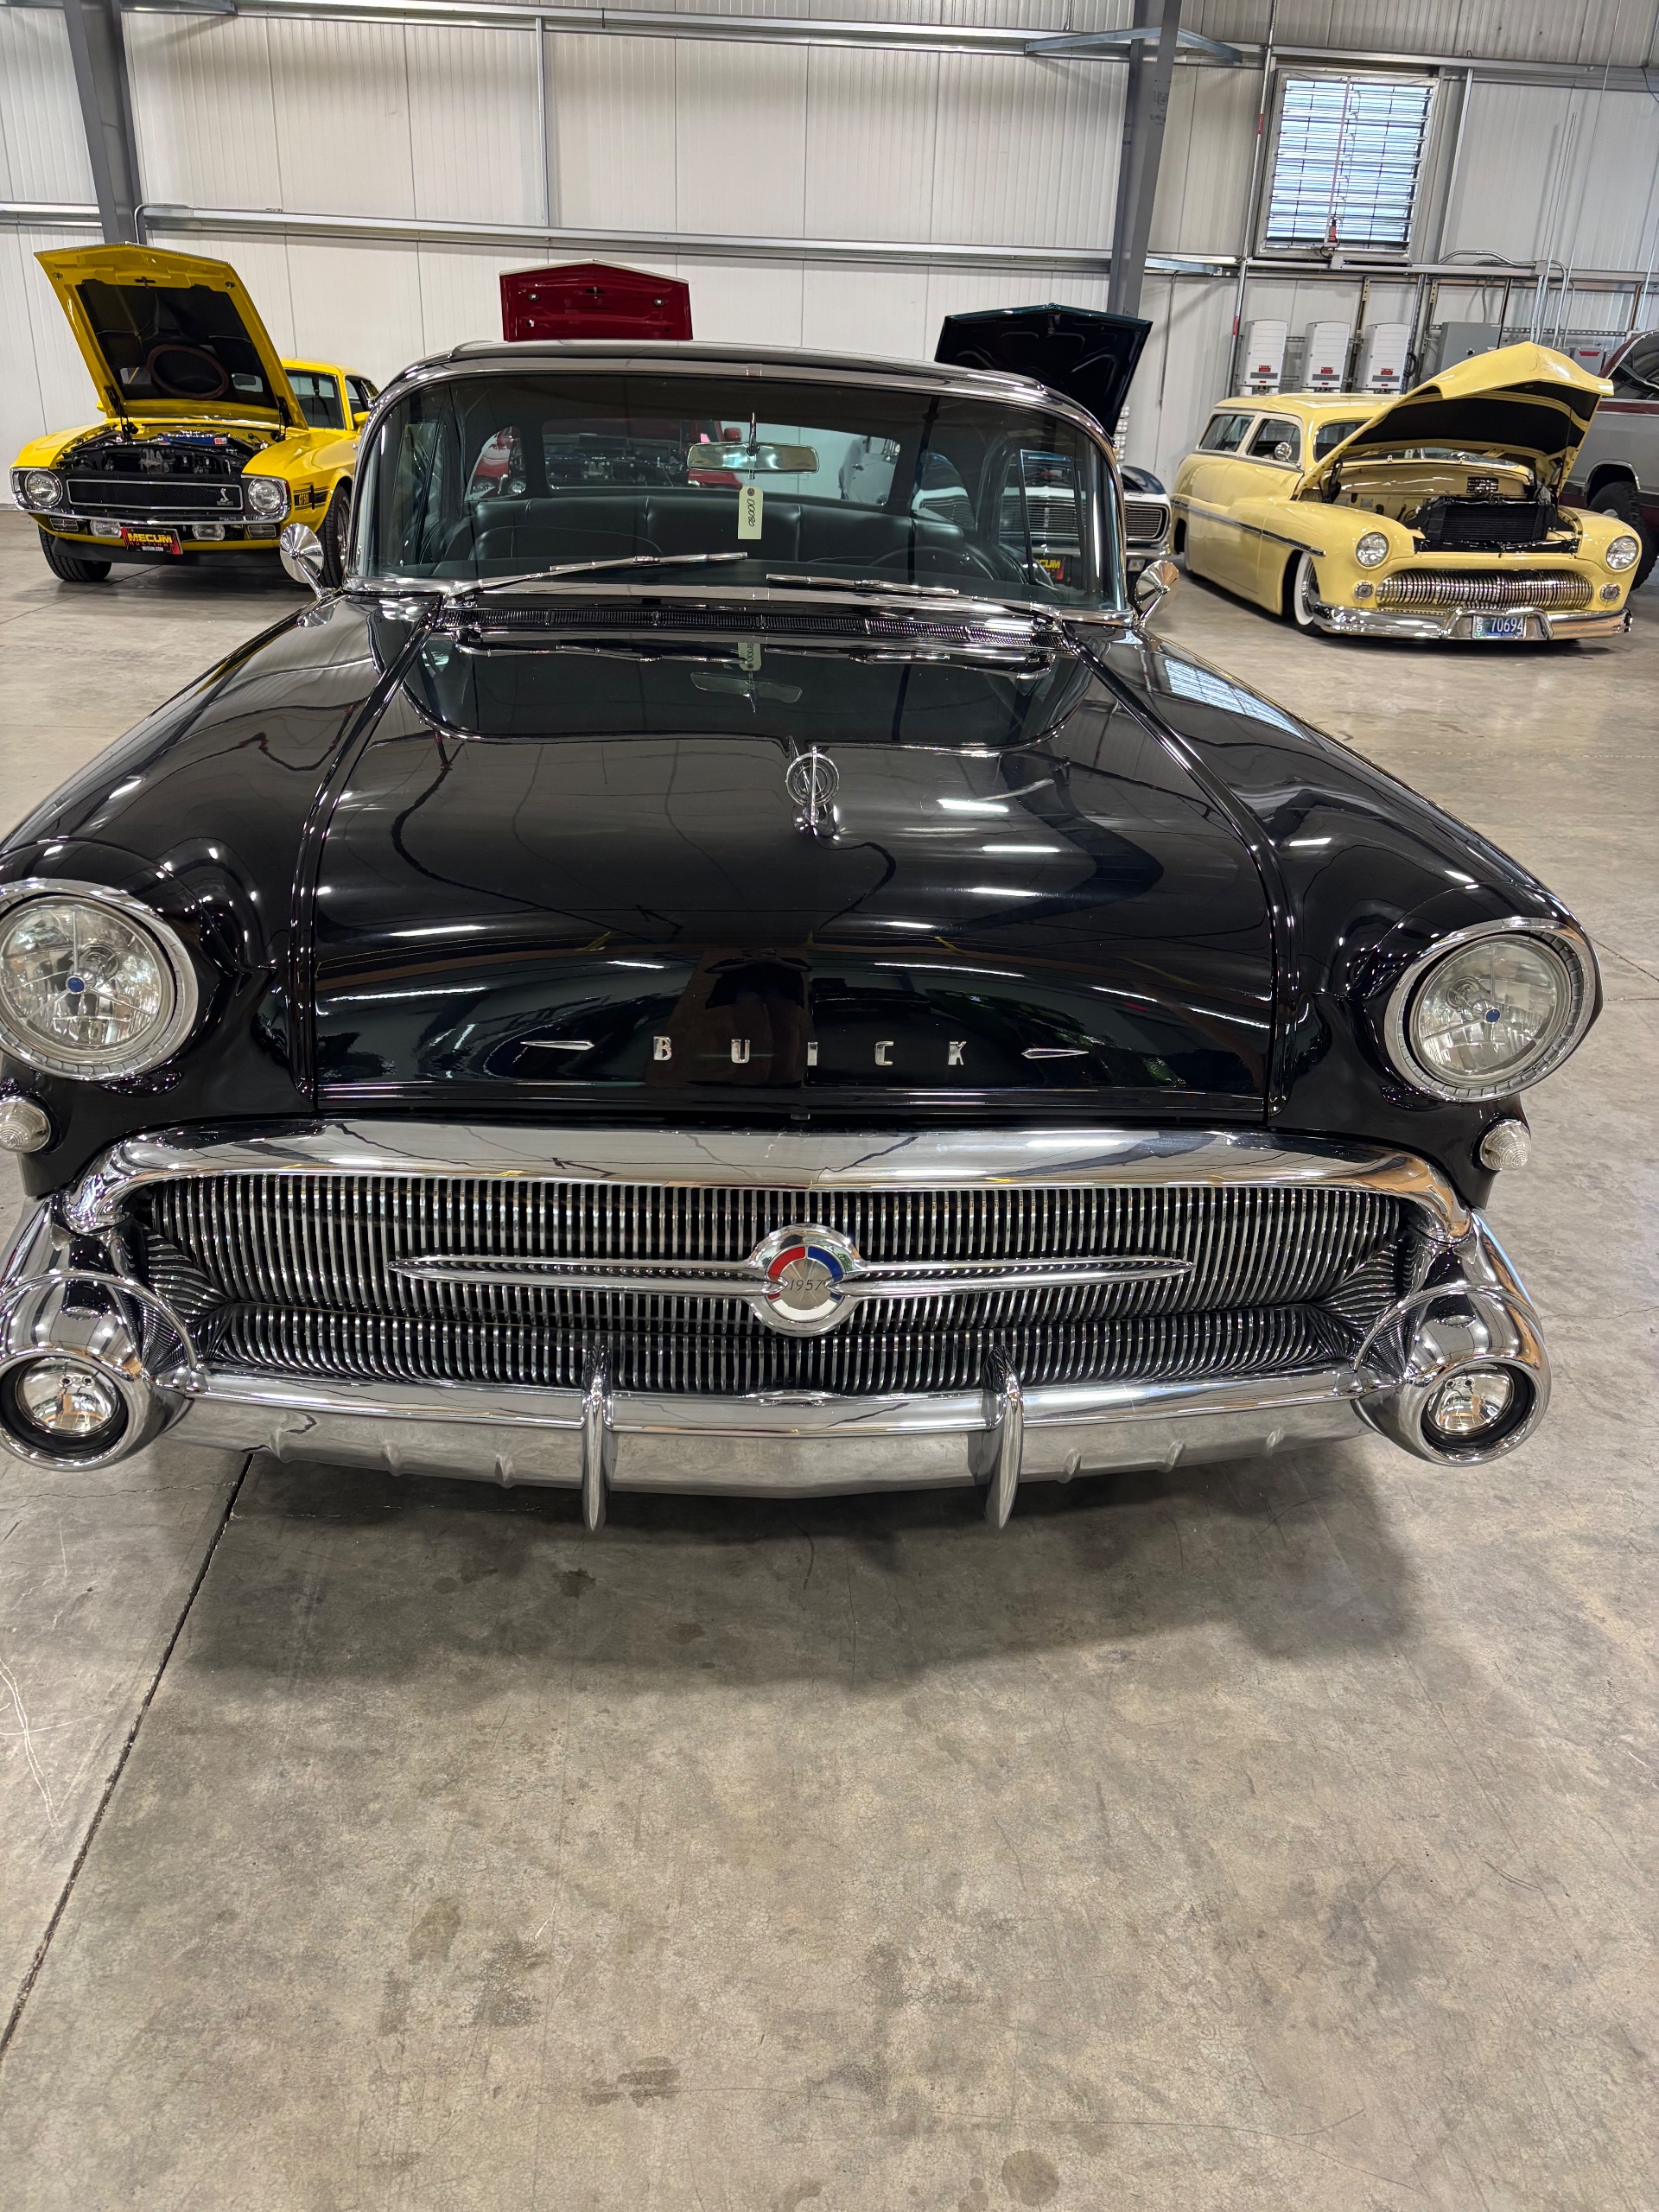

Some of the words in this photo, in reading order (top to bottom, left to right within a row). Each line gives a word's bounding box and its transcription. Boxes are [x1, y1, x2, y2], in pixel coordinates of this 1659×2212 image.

[127, 532, 173, 543] MECUM
[1039, 559, 1060, 569] CUM
[1491, 616, 1524, 632] 70694
[653, 1036, 967, 1066] BUICK
[790, 1280, 823, 1291] 1957
